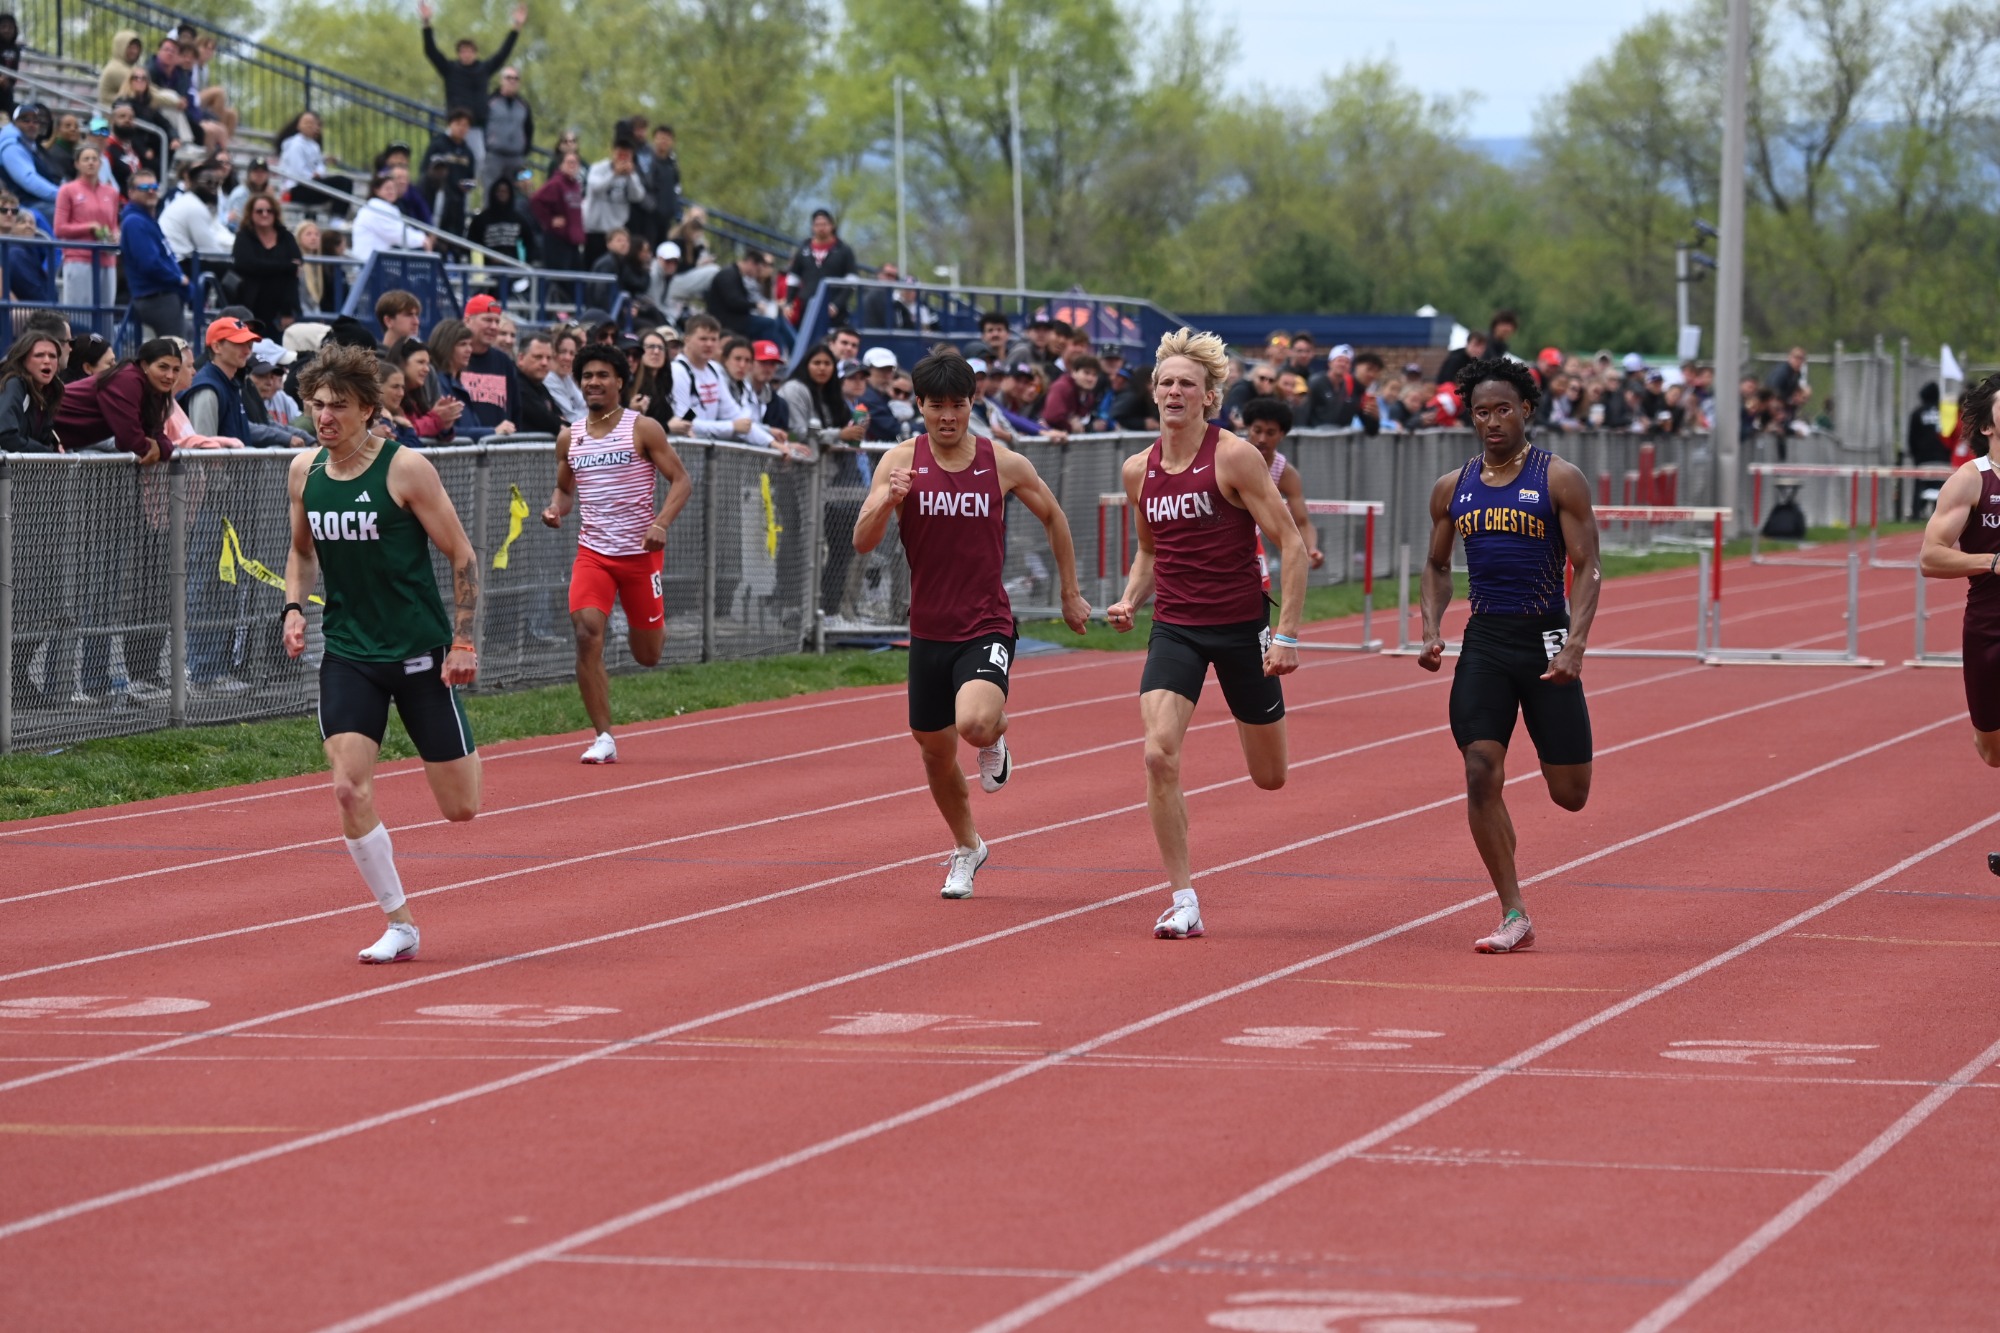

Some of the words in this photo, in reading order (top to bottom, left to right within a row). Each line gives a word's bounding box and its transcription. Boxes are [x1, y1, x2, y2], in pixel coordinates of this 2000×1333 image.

[573, 451, 632, 471] VULCANS
[919, 491, 990, 518] HAVEN
[1146, 491, 1213, 523] HAVEN
[1519, 492, 1538, 500] PSAC
[307, 511, 380, 541] ROCK
[1455, 509, 1481, 539] EST
[1485, 507, 1545, 539] CHESTER
[995, 645, 1008, 668] 5
[1549, 631, 1565, 657] 3
